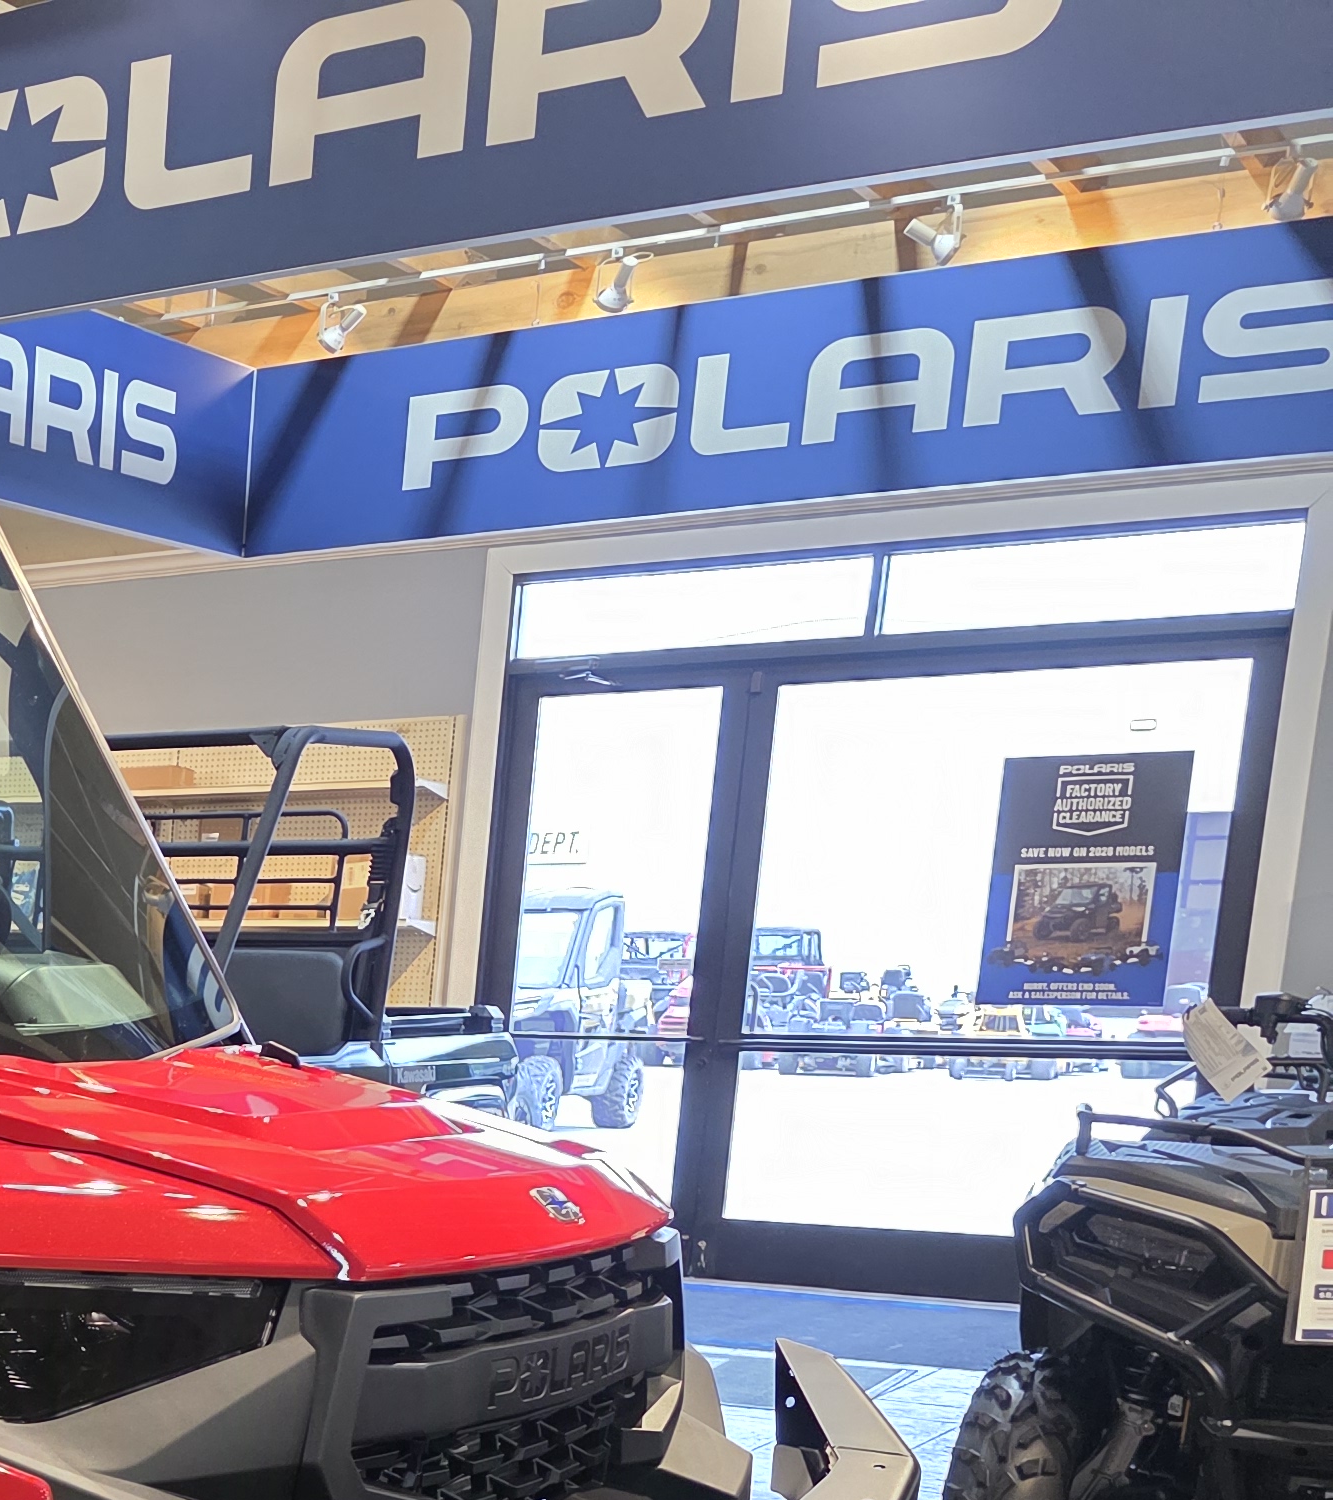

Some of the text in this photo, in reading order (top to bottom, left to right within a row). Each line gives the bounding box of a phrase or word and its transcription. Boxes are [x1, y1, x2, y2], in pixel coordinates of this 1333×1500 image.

[401, 277, 1333, 491] POLARIS
[1059, 763, 1135, 775] POLARIS
[1065, 783, 1122, 798] FACTORY
[1054, 797, 1132, 812] AUTHORIZED
[1058, 811, 1124, 824] CLEARANCE
[1020, 847, 1046, 858] SAVE
[1047, 847, 1072, 858] NOW
[1073, 847, 1087, 857] ON
[1115, 845, 1155, 857] MODELS
[487, 1324, 631, 1410] POLARIS
